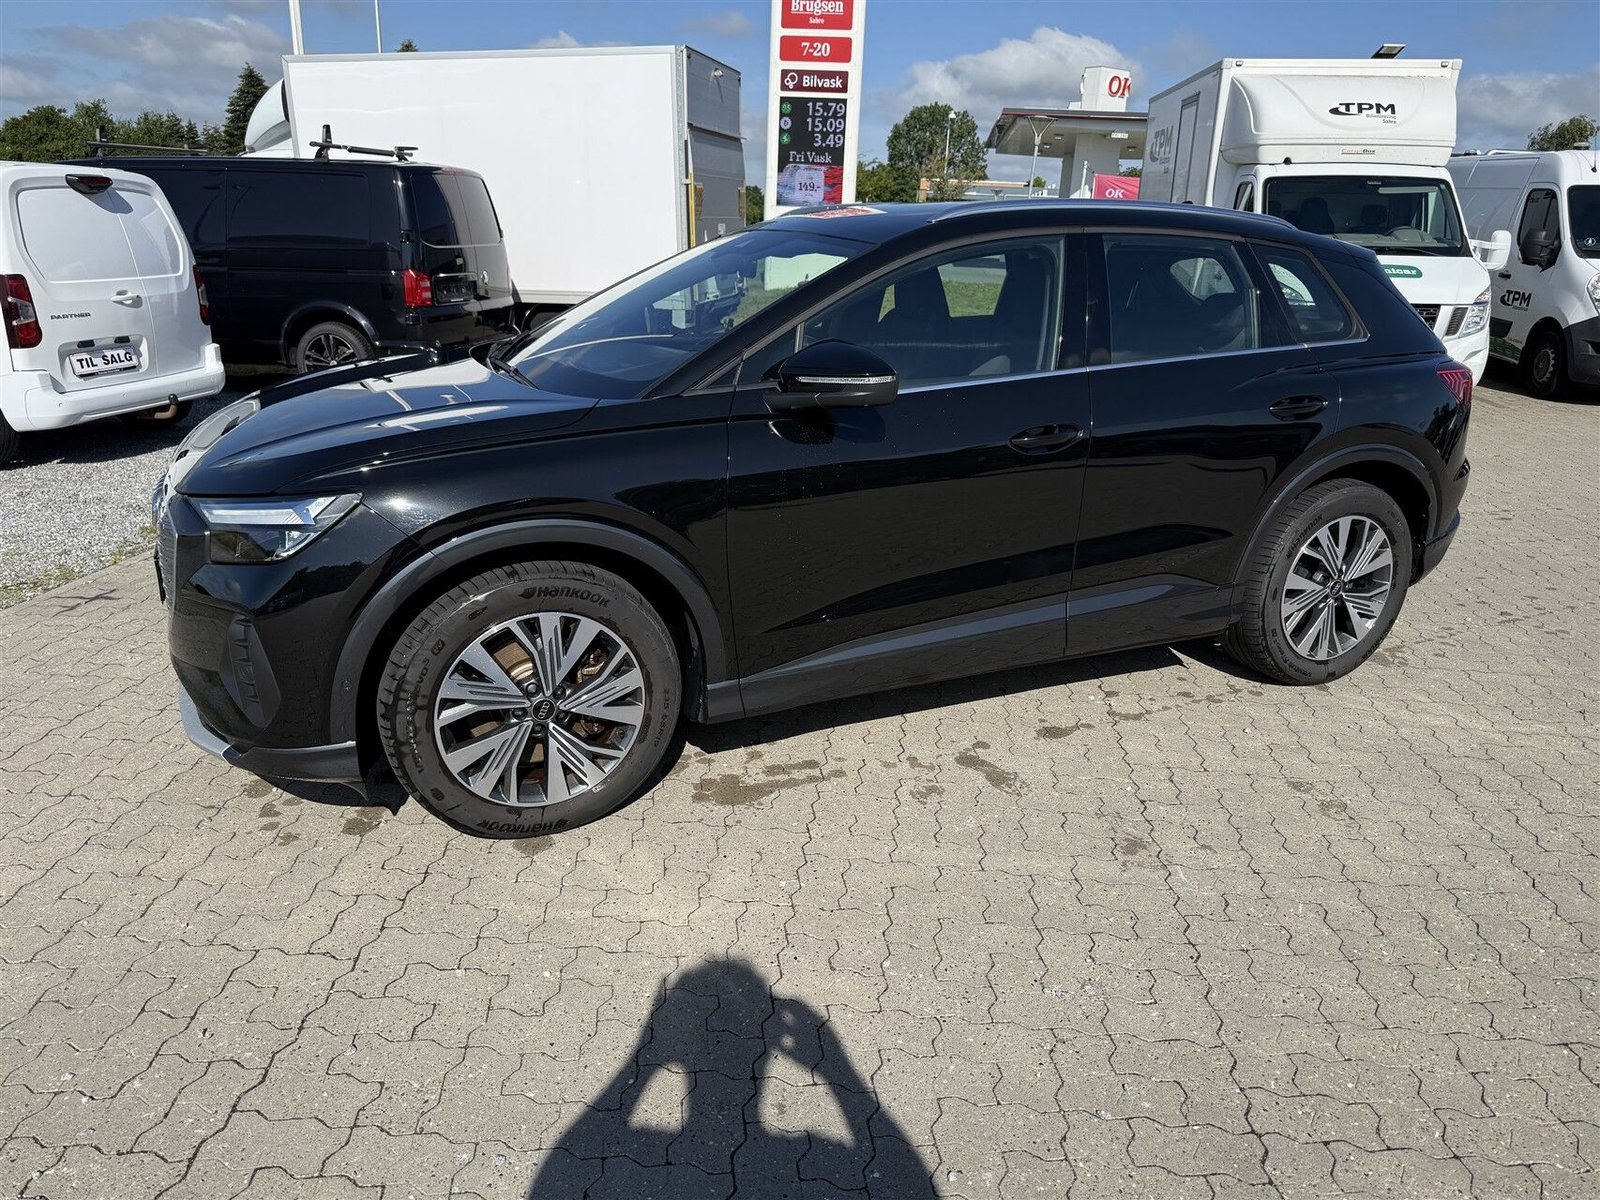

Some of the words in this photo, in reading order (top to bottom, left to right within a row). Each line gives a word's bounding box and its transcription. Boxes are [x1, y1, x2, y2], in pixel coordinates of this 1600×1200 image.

[791, 0, 844, 15] Brugsen
[801, 42, 831, 57] 7-20
[802, 75, 843, 89] Bilvask
[1108, 75, 1131, 97] OK
[807, 102, 845, 117] 15.79
[1339, 102, 1396, 115] TPM
[806, 117, 845, 132] 15.09
[813, 133, 844, 148] 3.49
[1154, 125, 1174, 158] TPM
[789, 151, 804, 162] Fri
[807, 152, 832, 163] Vask
[1105, 188, 1125, 199] OK
[1505, 289, 1532, 307] TPM
[50, 312, 91, 320] PARTNER
[76, 357, 98, 369] TIL
[101, 352, 133, 366] SALG
